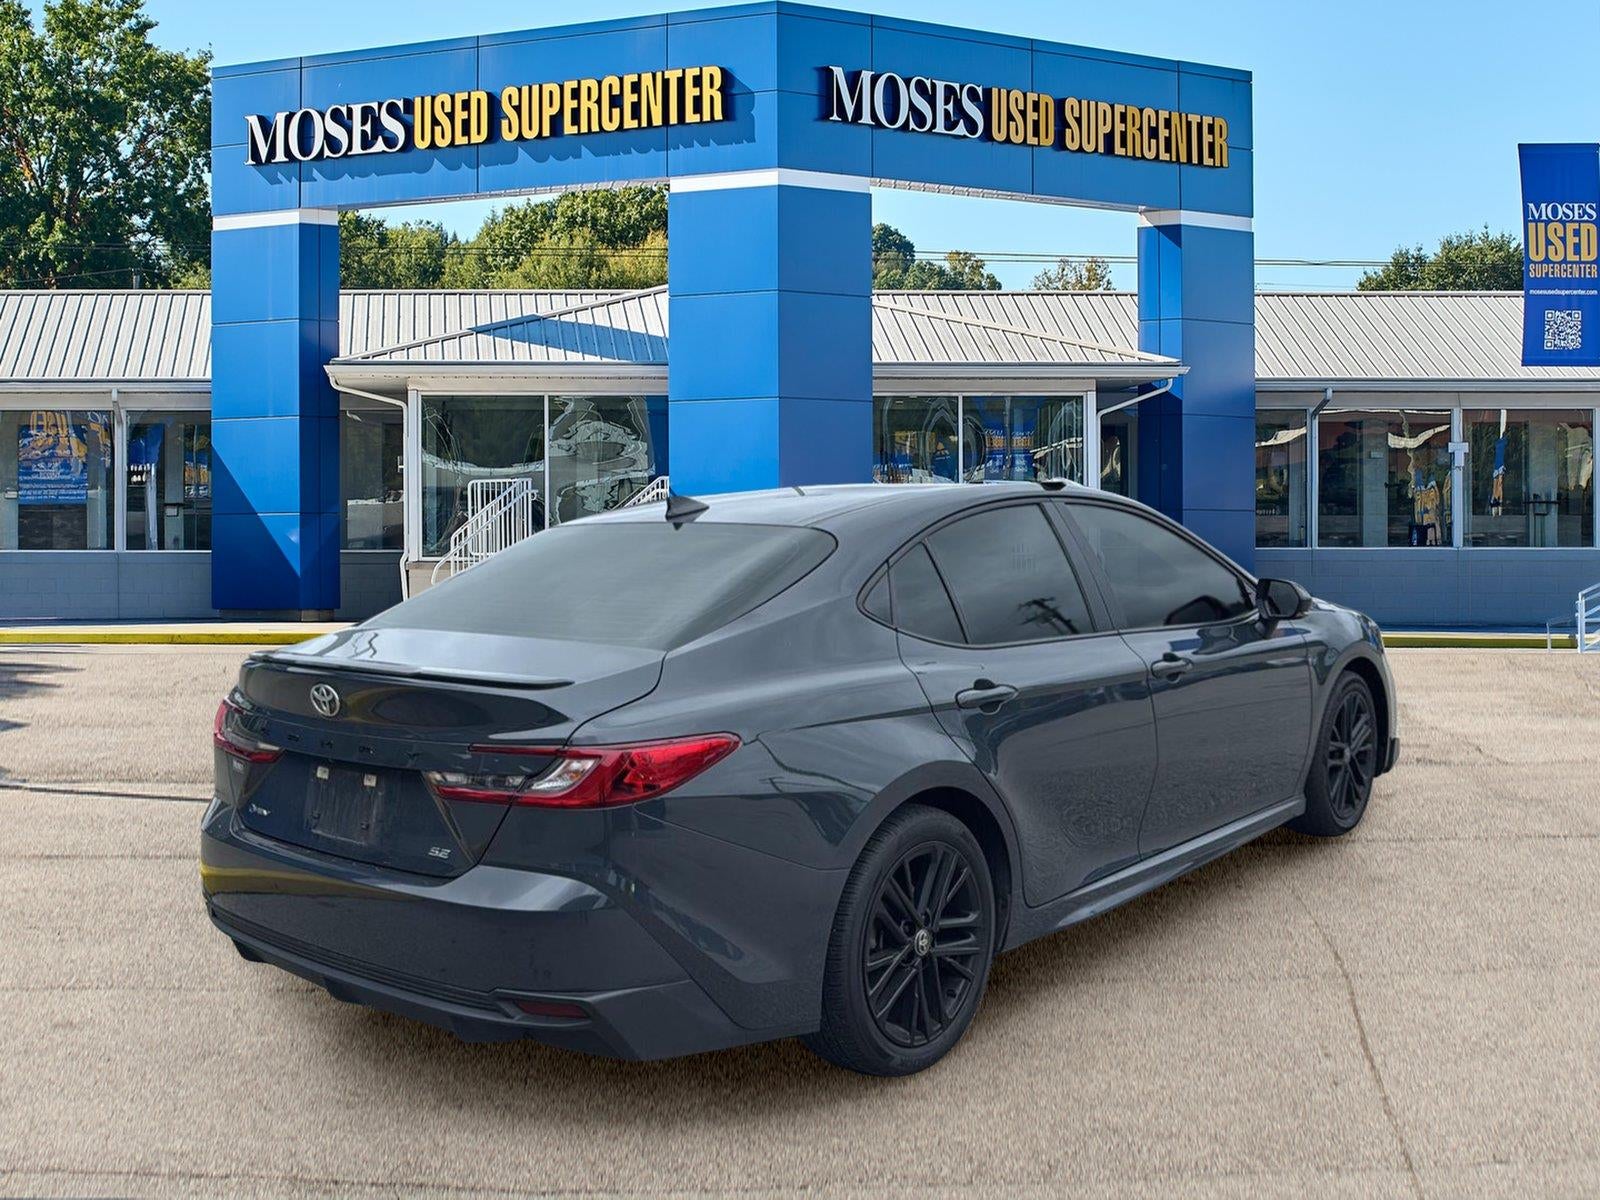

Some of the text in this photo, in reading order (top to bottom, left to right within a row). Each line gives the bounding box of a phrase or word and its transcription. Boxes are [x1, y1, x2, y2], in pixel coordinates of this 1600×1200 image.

[244, 65, 724, 166] MOSES USED SUPERCENTER
[828, 65, 1230, 168] MOSES USED SUPERCENTER
[1527, 202, 1597, 221] MOSES
[1528, 222, 1598, 262] USED
[1529, 263, 1598, 278] SUPERCENTER
[1529, 288, 1598, 296] mosesusedsupercenter.com
[428, 846, 451, 859] SE
